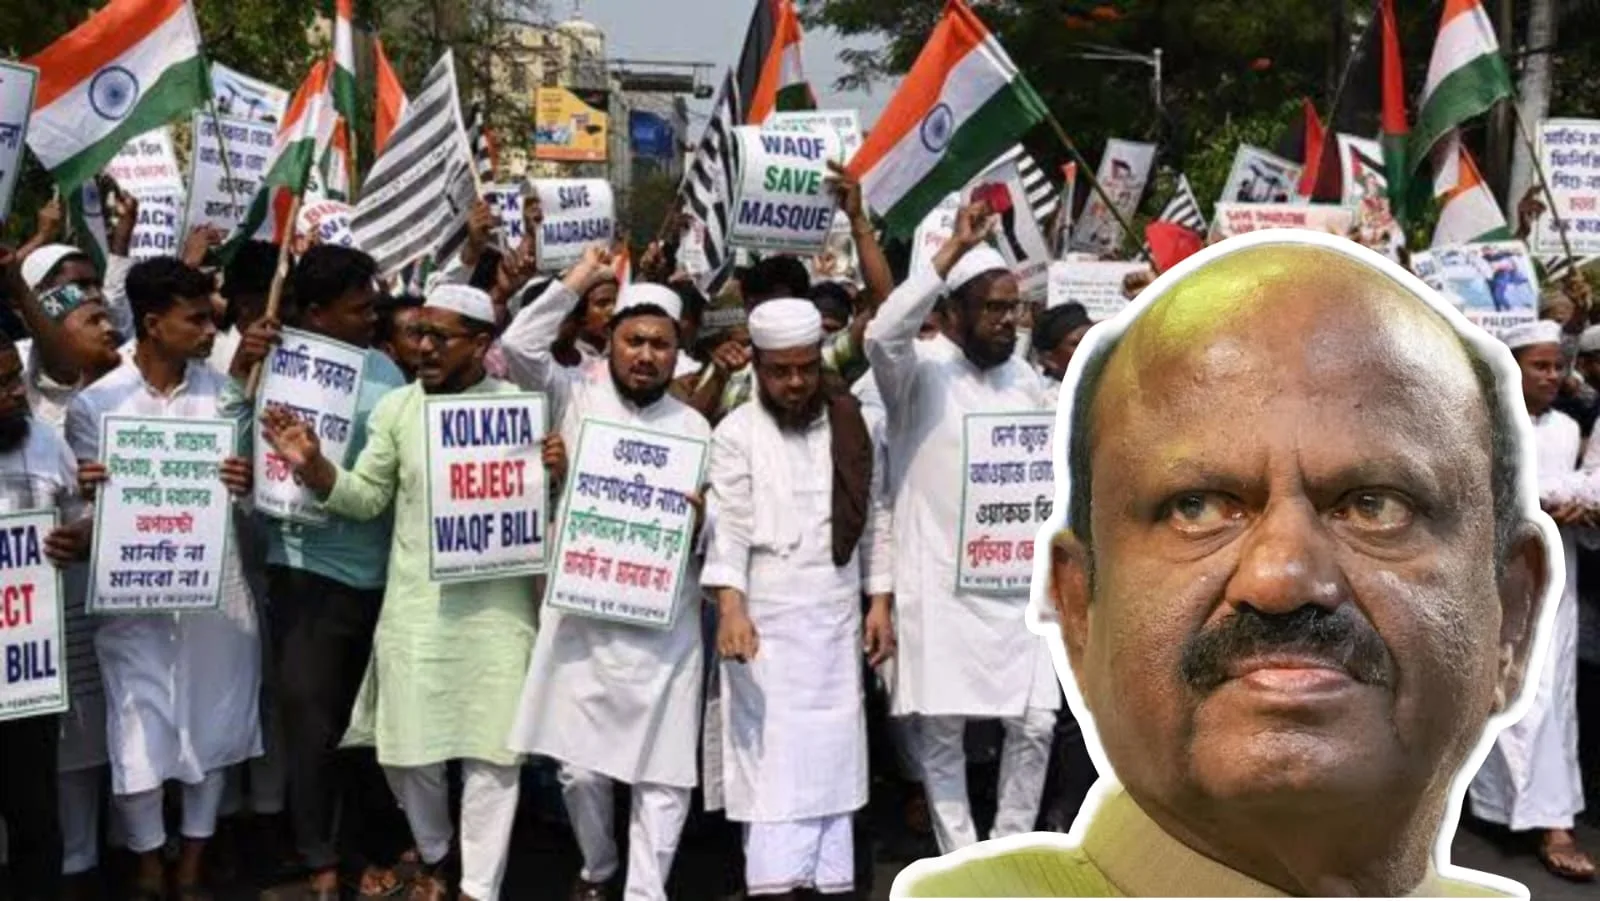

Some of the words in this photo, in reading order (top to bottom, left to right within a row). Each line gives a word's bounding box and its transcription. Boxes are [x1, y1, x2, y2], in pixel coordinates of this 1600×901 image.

[760, 135, 825, 161] WAQF
[764, 165, 821, 195] SAVE
[558, 185, 591, 210] SAVE
[738, 200, 831, 232] MASQUE
[312, 357, 358, 394] সরকার
[441, 407, 533, 448] KOLKATA
[991, 424, 1016, 447] দেশ
[450, 459, 526, 499] REJECT
[970, 462, 1025, 485] আওয়াজ
[976, 501, 1032, 526] ওয়াকফ
[1034, 495, 1054, 523] বি
[435, 513, 494, 553] WAQF
[501, 509, 542, 547] BILL
[120, 539, 178, 562] মানছি
[184, 544, 205, 562] না
[109, 570, 174, 588] মানবো
[6, 639, 57, 684] BILL
